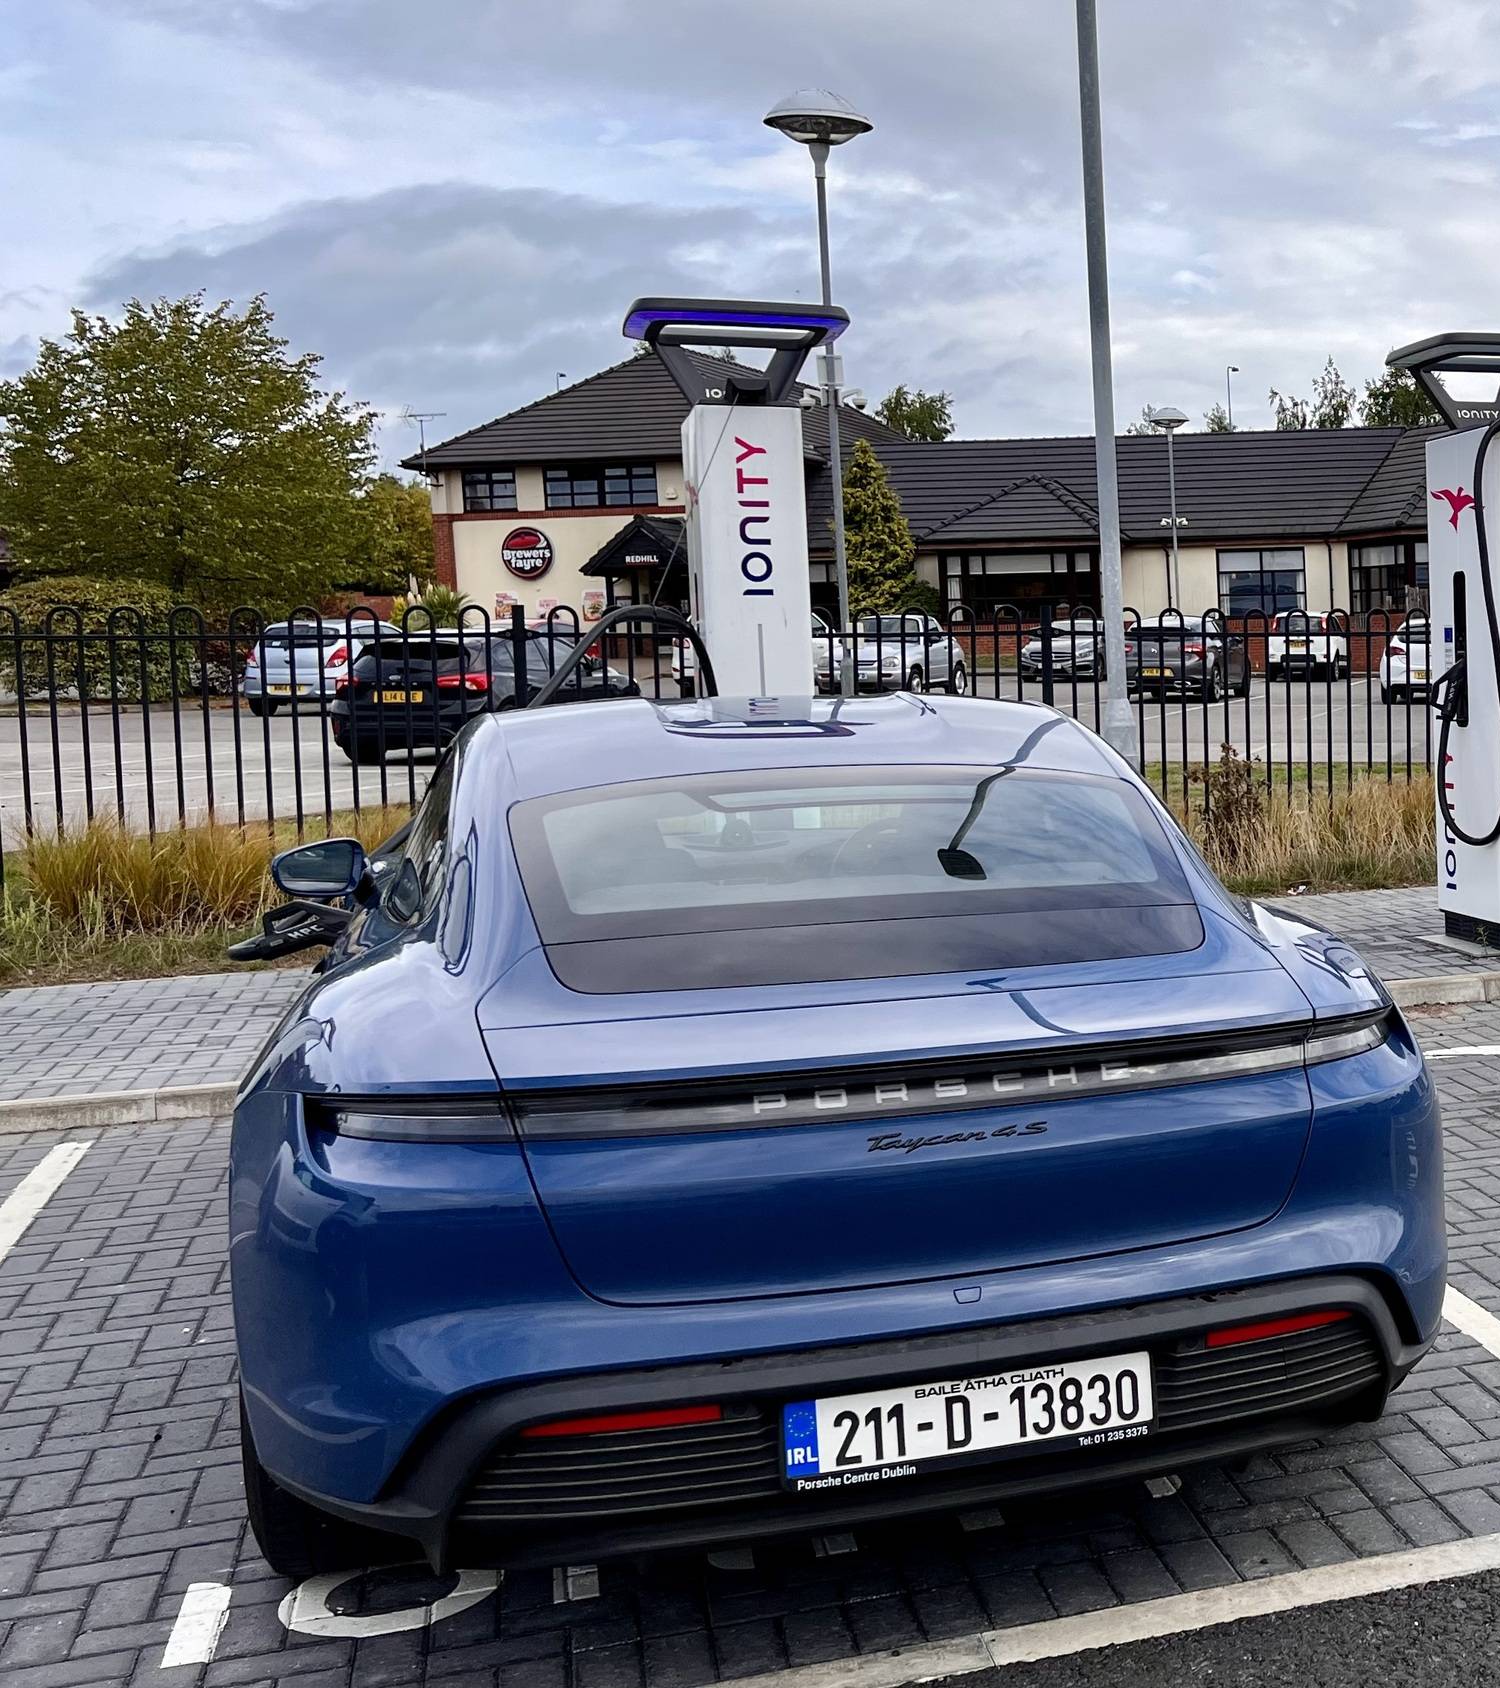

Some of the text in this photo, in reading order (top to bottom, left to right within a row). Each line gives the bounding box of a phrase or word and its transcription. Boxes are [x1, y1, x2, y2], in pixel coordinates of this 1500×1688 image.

[1457, 409, 1499, 419] IONITY
[735, 436, 774, 596] IONITY
[503, 549, 551, 560] Brewers
[511, 557, 543, 570] fayre
[625, 555, 659, 563] REDHILL
[287, 924, 324, 940] HPC
[753, 1061, 1131, 1114] PORSCHE
[867, 1121, 1049, 1154] Taycan 4S
[914, 1383, 961, 1399] BAILE
[1010, 1367, 1065, 1385] CLIATH
[833, 1369, 1139, 1467] 211-D-13830
[1078, 1425, 1148, 1446] Tel: 01 235 3375
[787, 1446, 818, 1466] IRL
[797, 1464, 917, 1491] Porsche Centre Dublin
